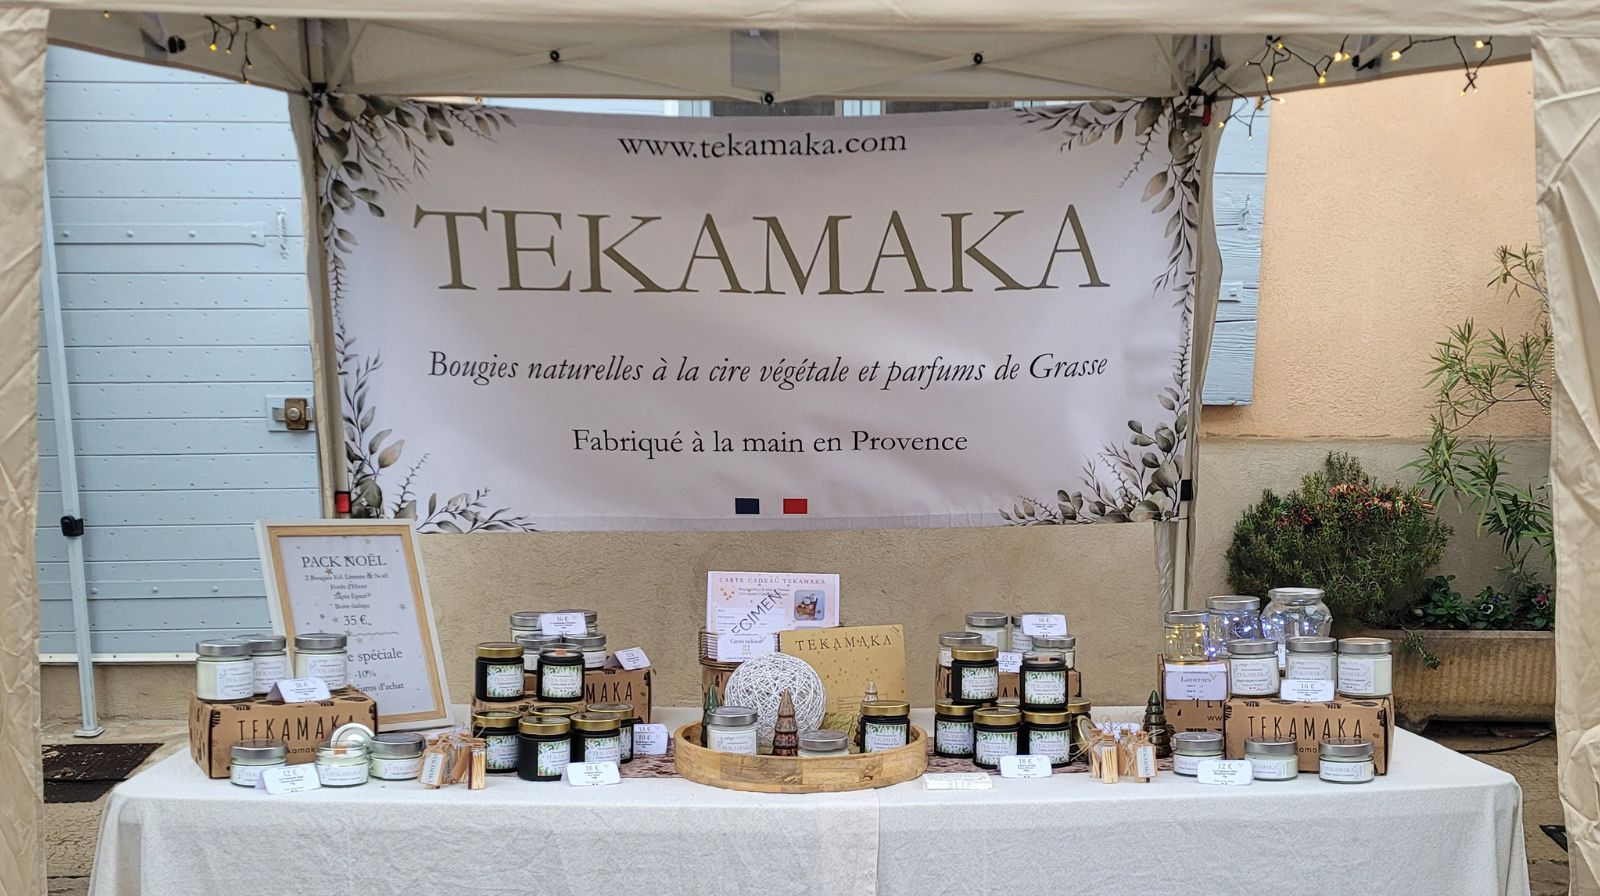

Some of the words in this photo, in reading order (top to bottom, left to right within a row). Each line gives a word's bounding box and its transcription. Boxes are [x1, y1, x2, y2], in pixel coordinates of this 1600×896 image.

[618, 132, 907, 158] www.tekamaka.com
[413, 203, 1111, 295] TEKAMAKA
[428, 351, 519, 386] Bougies
[528, 355, 644, 381] naturelles
[652, 357, 668, 381] à
[677, 357, 699, 382] la
[709, 357, 751, 382] cire
[759, 356, 850, 390] végétale
[858, 360, 880, 382] et
[880, 356, 986, 390] parfums
[994, 354, 1019, 381] de
[1029, 353, 1108, 379] Grasse
[572, 429, 684, 459] Fabriqué
[692, 431, 705, 452] à
[713, 430, 734, 452] la
[742, 431, 805, 452] main
[813, 437, 842, 452] en
[851, 430, 968, 451] Provence
[301, 556, 342, 568] PACK
[344, 553, 387, 567] NOËL
[344, 615, 357, 626] 35
[795, 634, 893, 652] TEKAMAKA
[357, 648, 403, 664] spéciale
[1248, 715, 1362, 740] TEKAMAKA
